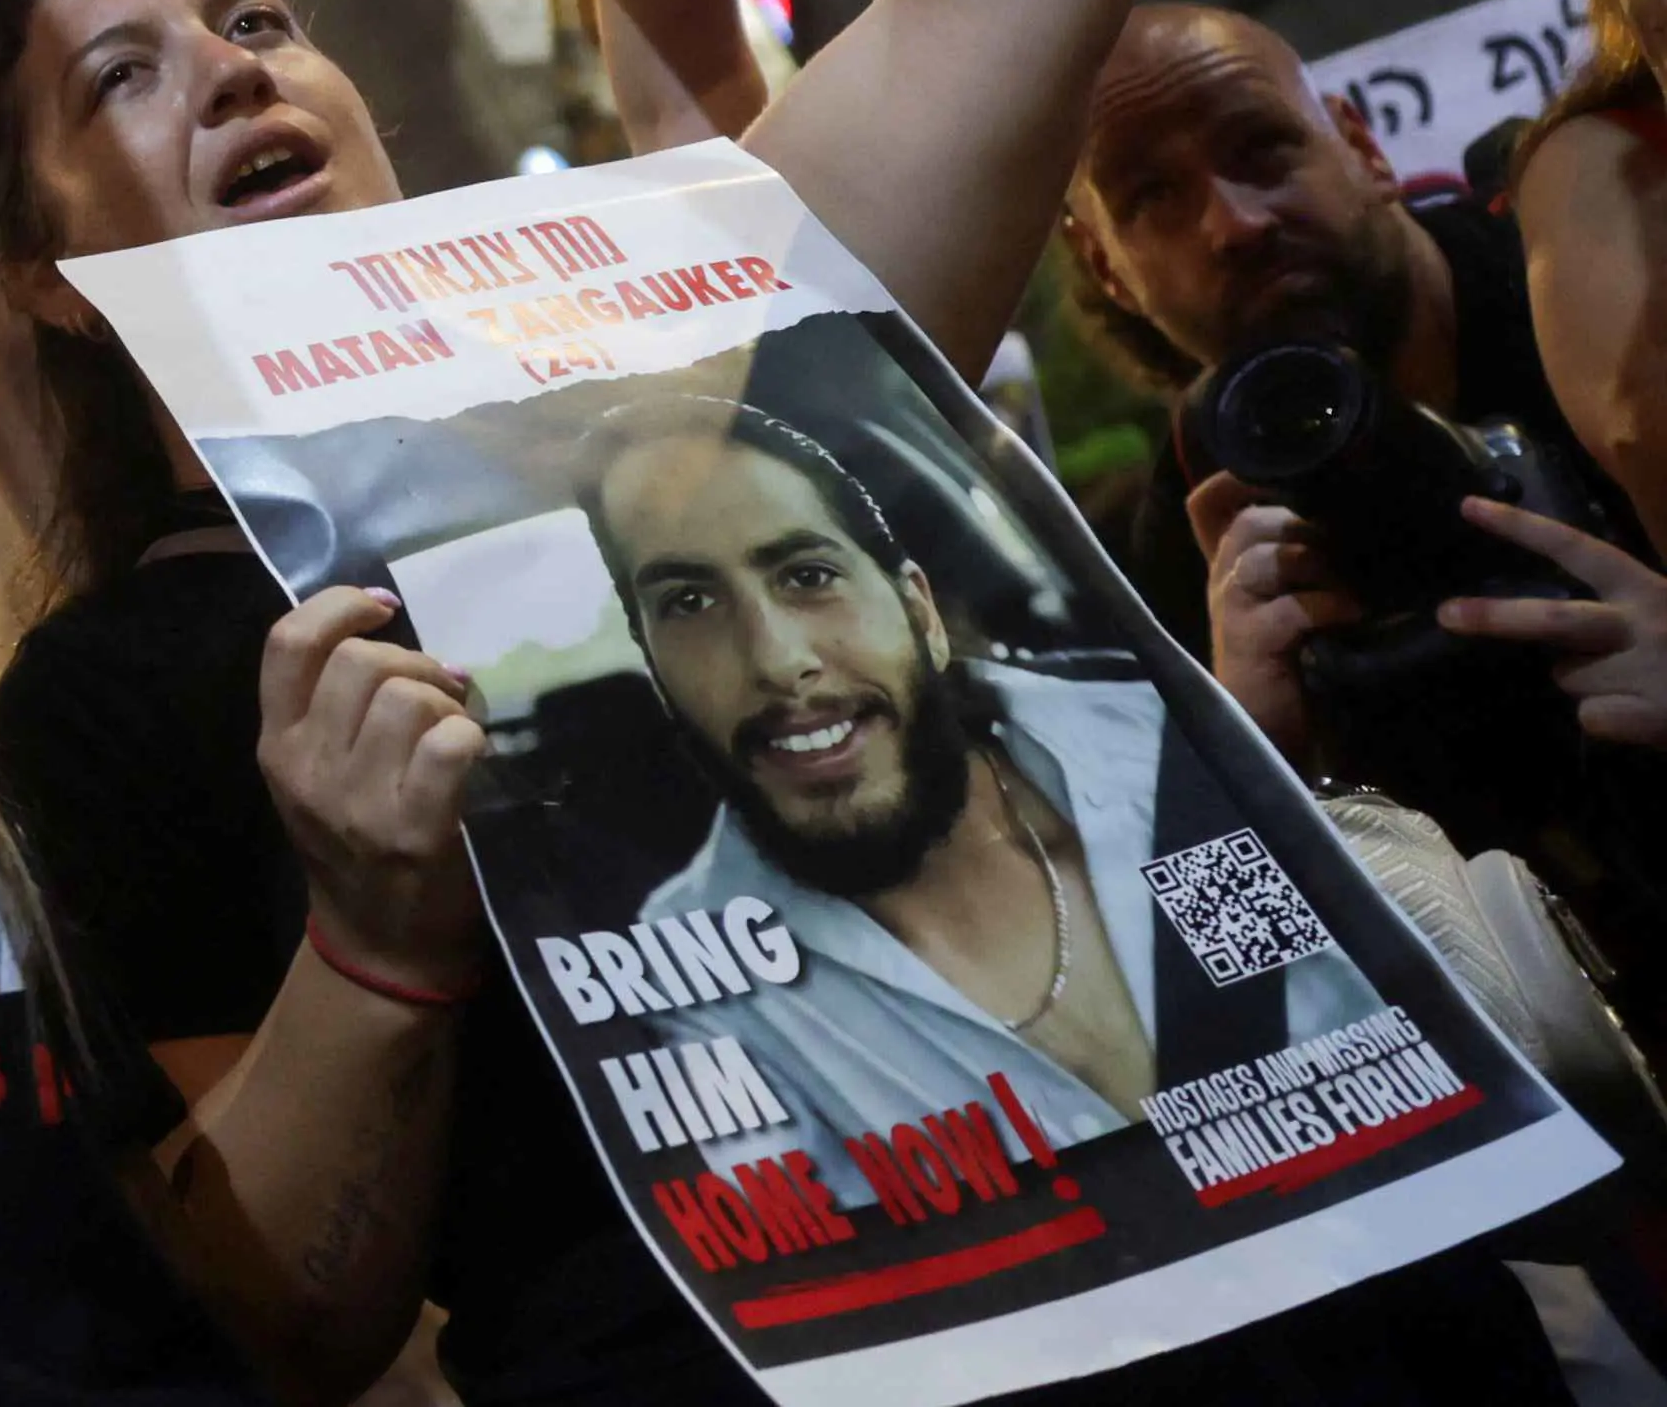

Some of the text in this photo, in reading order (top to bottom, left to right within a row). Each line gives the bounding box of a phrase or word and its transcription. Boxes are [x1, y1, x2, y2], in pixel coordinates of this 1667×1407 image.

[252, 254, 794, 397] MATAN ZANGAUKER
[328, 214, 628, 313] מתן צנגאוקר
[514, 337, 617, 386] (24)
[535, 895, 801, 1025] BRING
[599, 1036, 789, 1153] HIM
[1139, 1005, 1422, 1135] HOSTAGES AND MISSING
[1164, 1041, 1465, 1190] FAMILIES FORUM
[651, 1070, 1080, 1272] HOME NOW!
